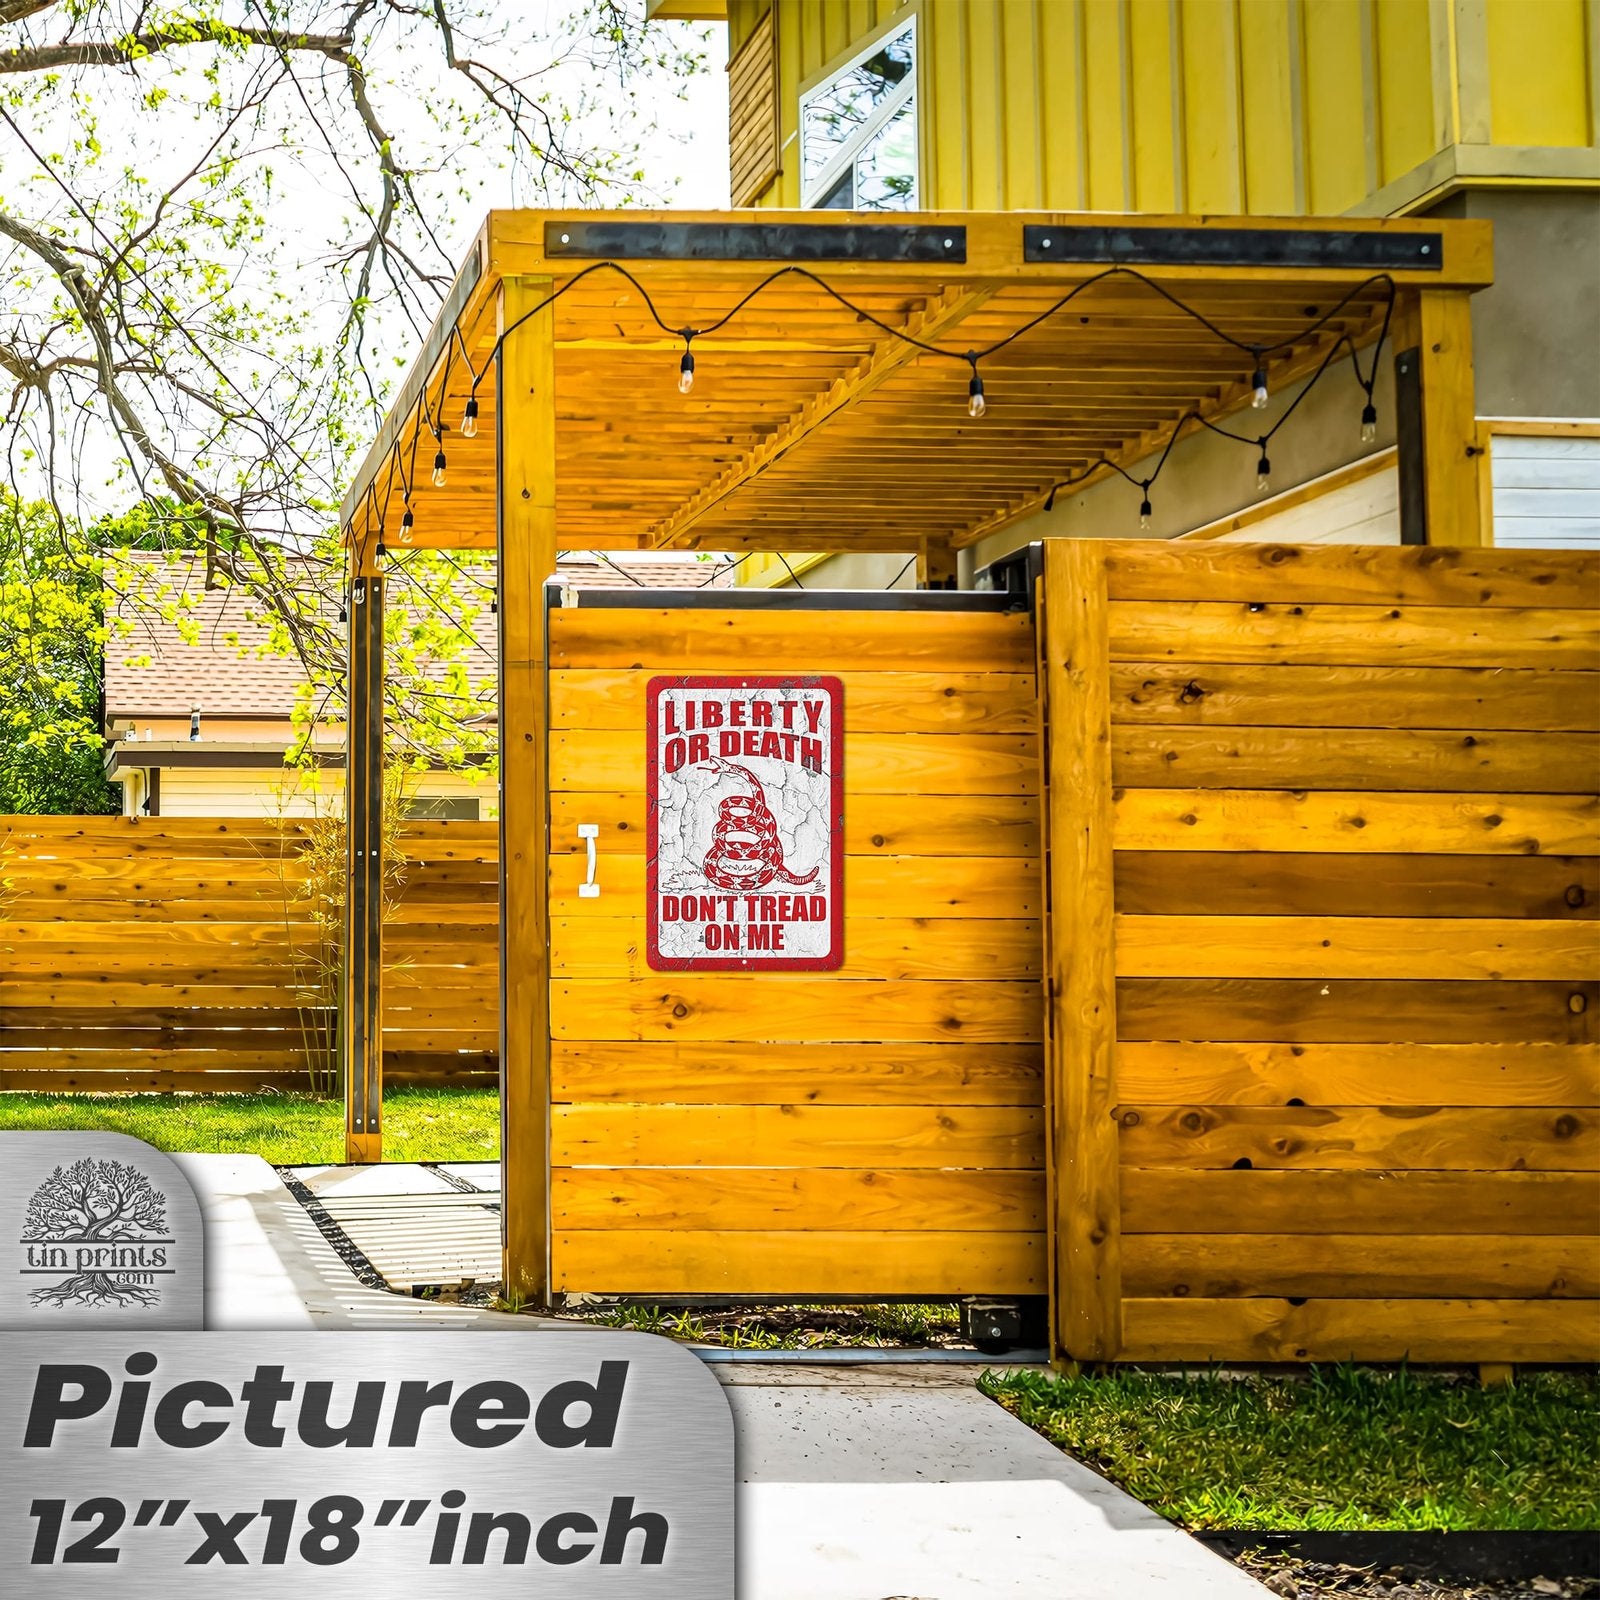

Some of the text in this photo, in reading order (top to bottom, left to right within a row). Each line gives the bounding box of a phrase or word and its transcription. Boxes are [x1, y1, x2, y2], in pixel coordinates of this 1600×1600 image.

[664, 700, 824, 735] LIBERTY
[664, 730, 822, 775] OR DEATH
[662, 895, 826, 922] DON'T TREAD
[705, 923, 784, 951] ON ME
